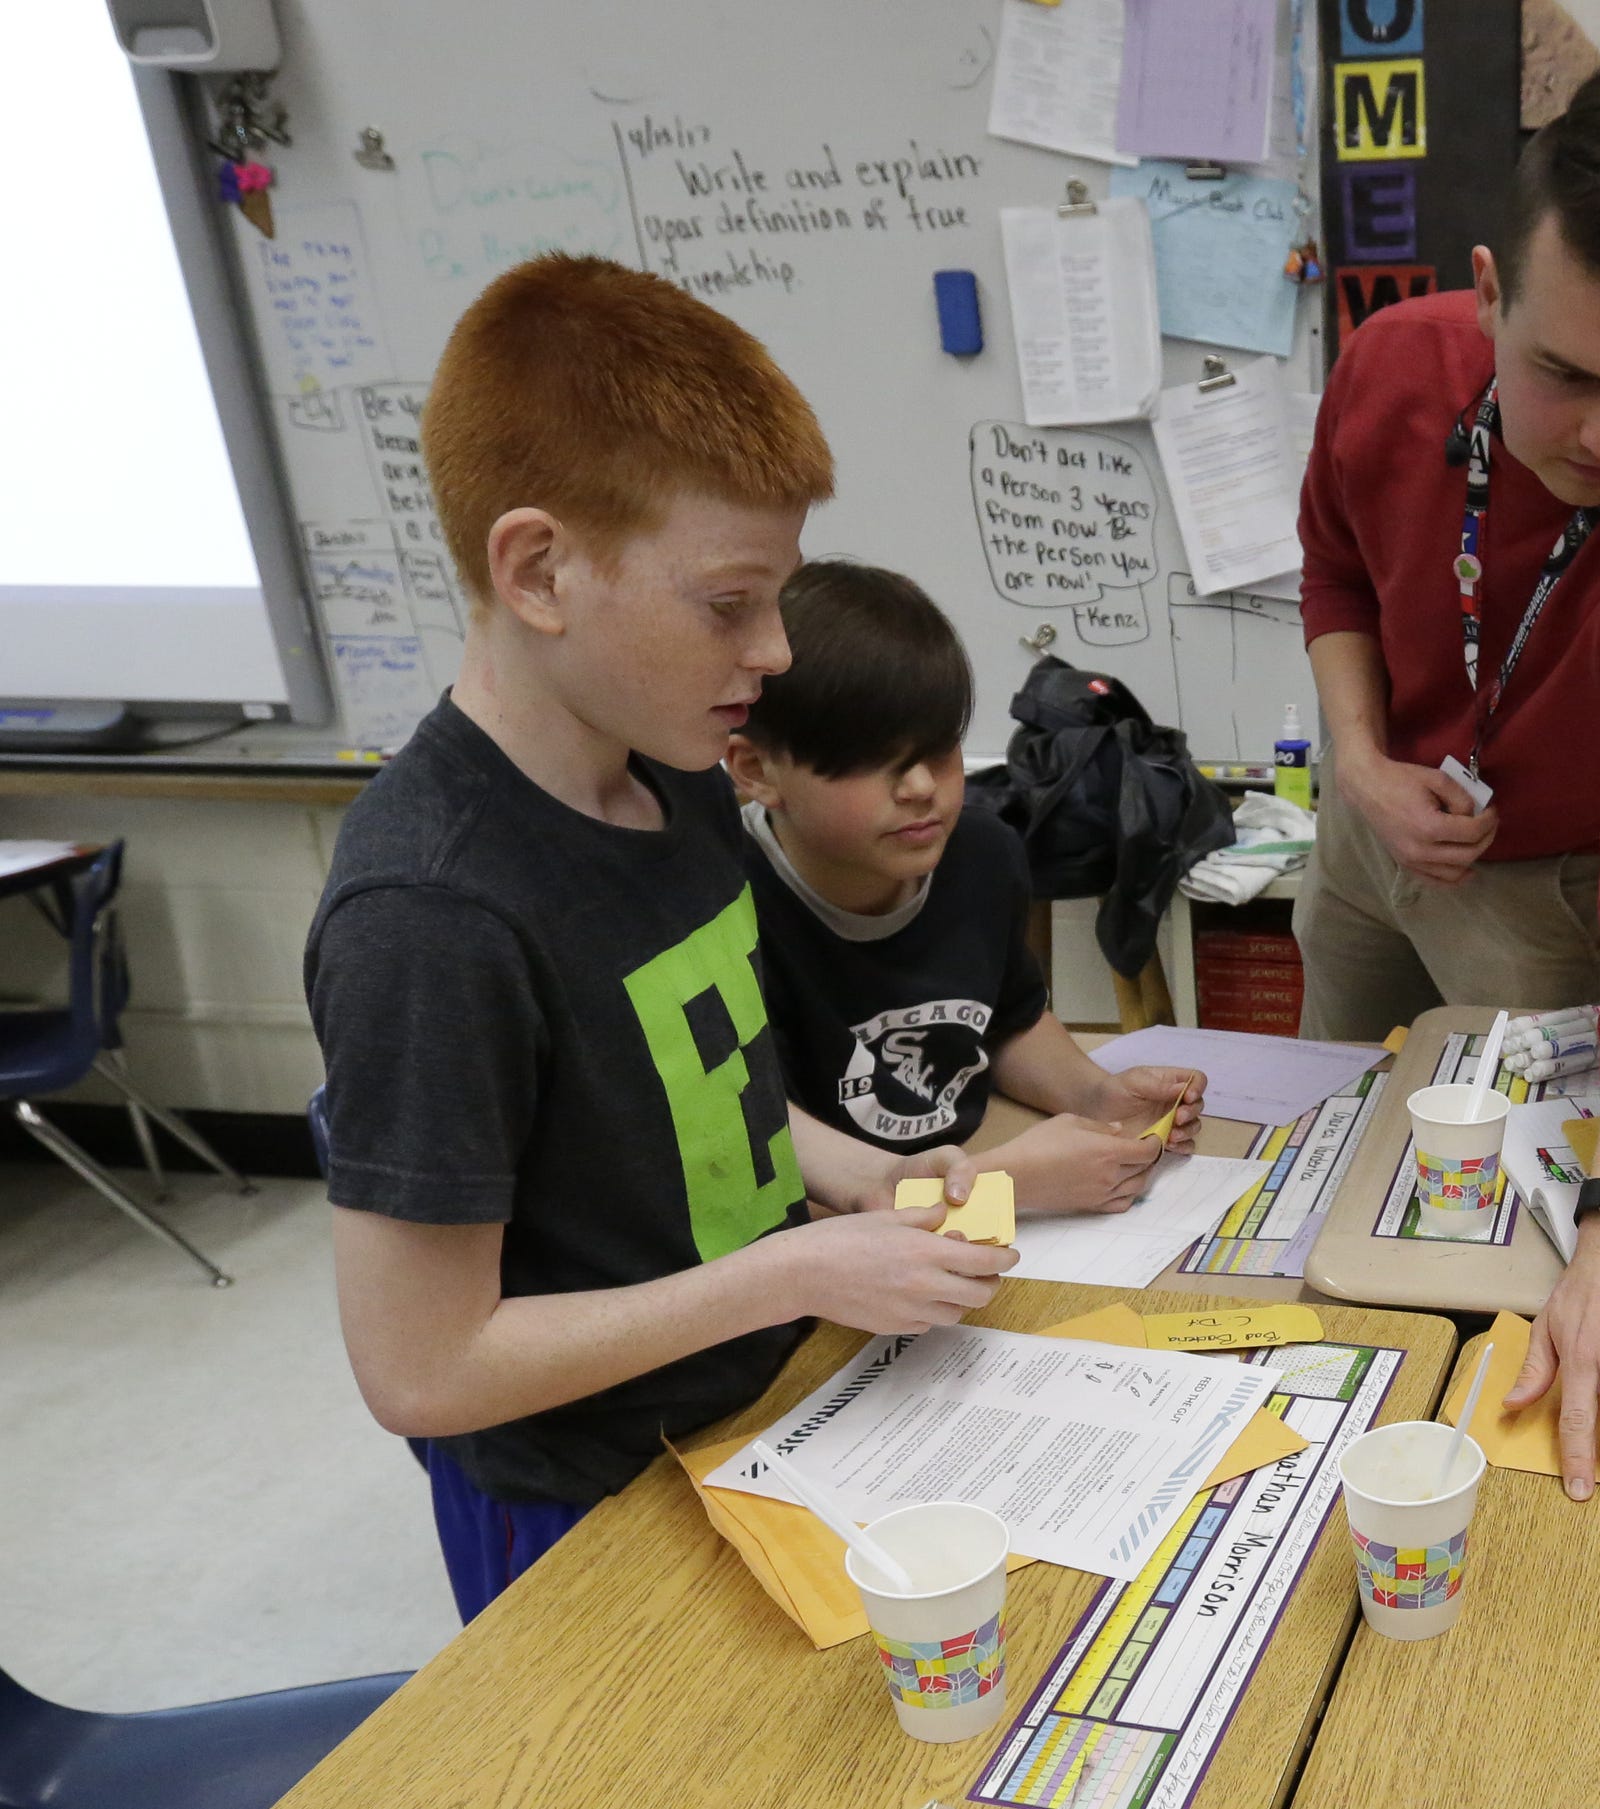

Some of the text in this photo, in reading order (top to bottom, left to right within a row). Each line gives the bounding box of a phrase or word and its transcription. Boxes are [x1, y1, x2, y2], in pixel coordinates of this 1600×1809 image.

[675, 138, 981, 200] Write and explain
[716, 197, 852, 235] definition
[863, 199, 888, 231] of
[908, 194, 970, 232] true
[992, 424, 1133, 475] Don't act like
[1070, 485, 1083, 511] 3
[991, 534, 1027, 556] the
[1004, 571, 1034, 590] are
[843, 1077, 873, 1099] 19
[876, 1109, 950, 1136] WHITE
[1245, 1331, 1281, 1342] Bad
[1167, 1376, 1213, 1423] FEED THE GUT
[1252, 1442, 1322, 1515] nathan
[1196, 1530, 1272, 1618] Morrison
